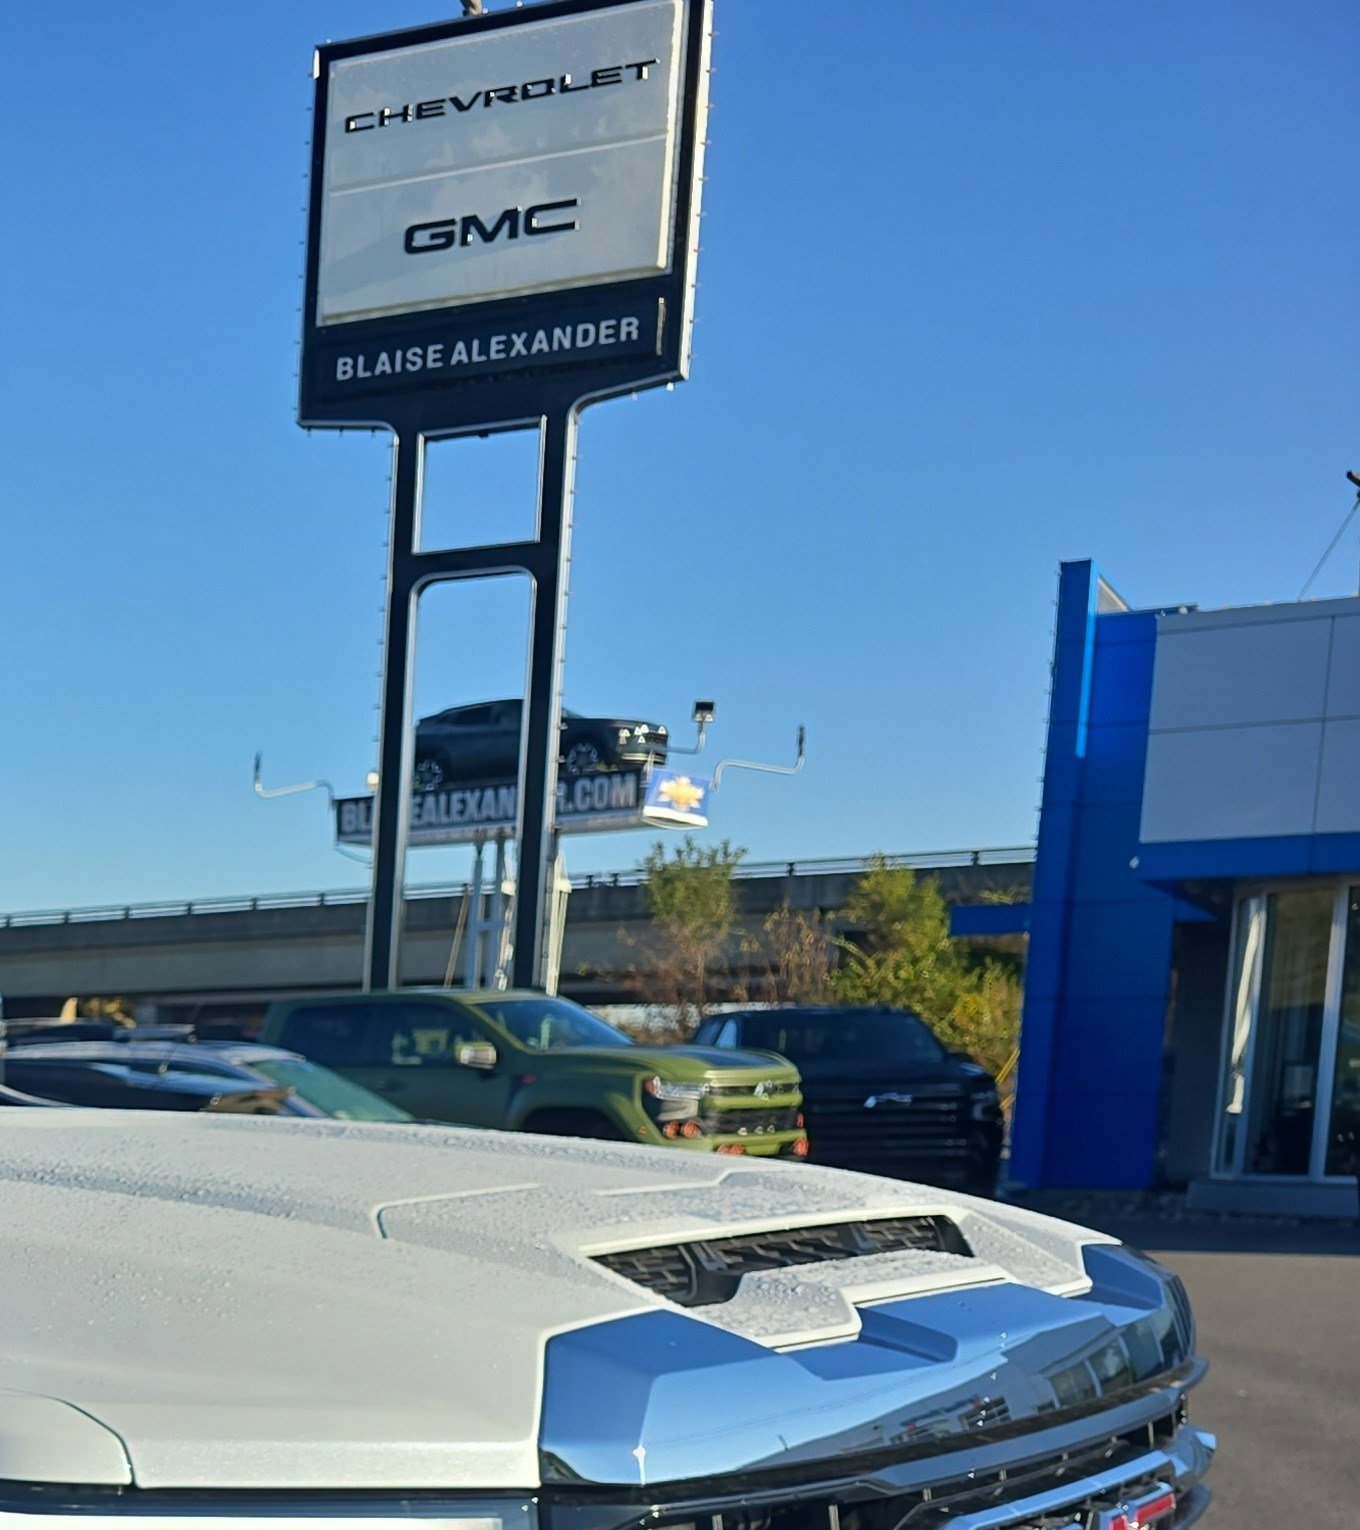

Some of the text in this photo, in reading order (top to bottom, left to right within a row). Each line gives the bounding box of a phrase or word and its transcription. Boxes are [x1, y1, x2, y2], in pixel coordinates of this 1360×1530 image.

[344, 58, 661, 133] CHEVROLET
[404, 198, 582, 254] GMC
[336, 316, 640, 381] BLAISE ALEXANDER
